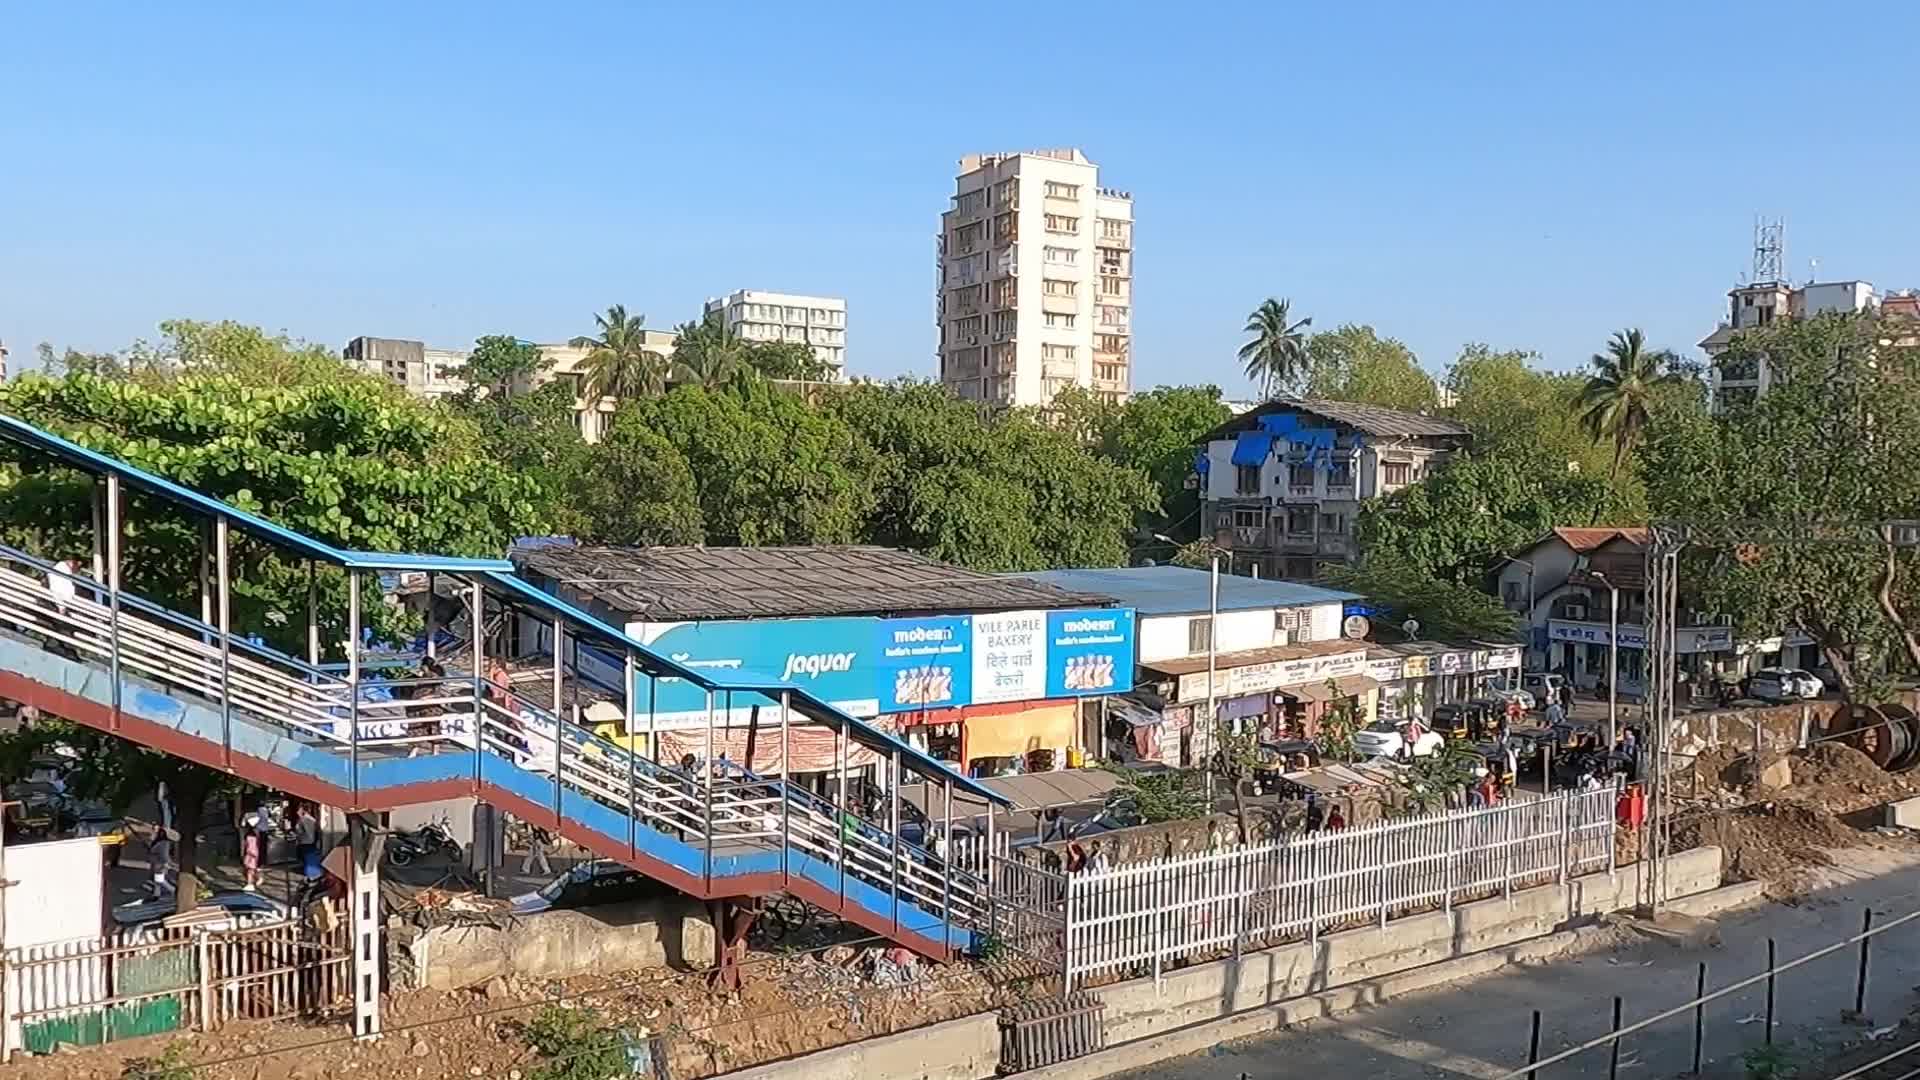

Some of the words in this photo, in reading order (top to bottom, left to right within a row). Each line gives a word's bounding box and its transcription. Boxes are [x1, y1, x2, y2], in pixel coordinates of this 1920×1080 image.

[979, 621, 1002, 633] VILE
[1007, 618, 1041, 631] PARLE
[1064, 618, 1116, 633] modern
[893, 627, 954, 643] modern
[988, 633, 1033, 648] BAKERY
